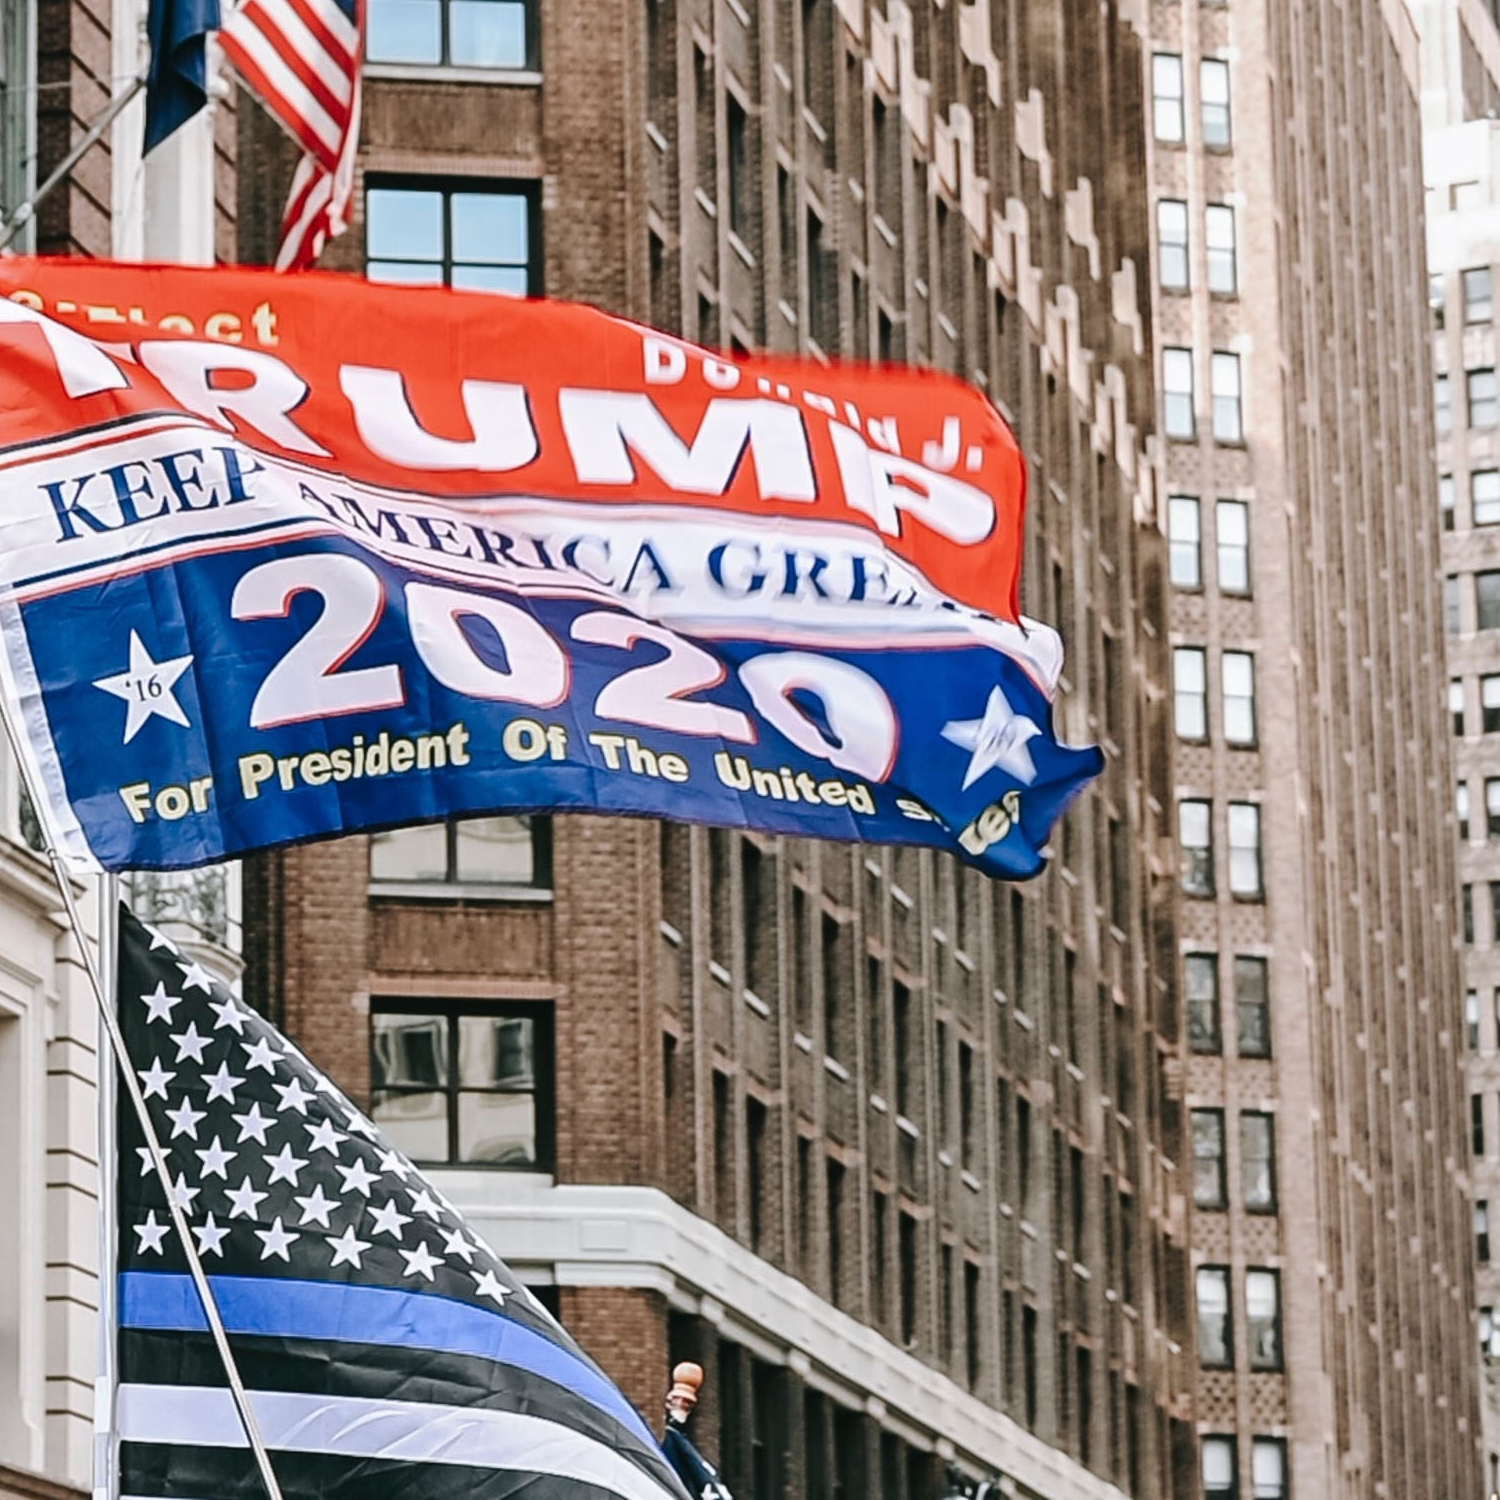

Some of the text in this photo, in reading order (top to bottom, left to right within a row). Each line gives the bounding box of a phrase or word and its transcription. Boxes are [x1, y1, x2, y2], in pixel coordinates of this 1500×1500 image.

[38, 446, 268, 544] KEEP
[298, 481, 683, 593] AMERICA
[230, 553, 898, 785] 2020
[118, 775, 214, 824] For
[238, 722, 471, 800] President
[502, 719, 569, 763] Of
[589, 733, 690, 783] The
[714, 750, 876, 816] United
